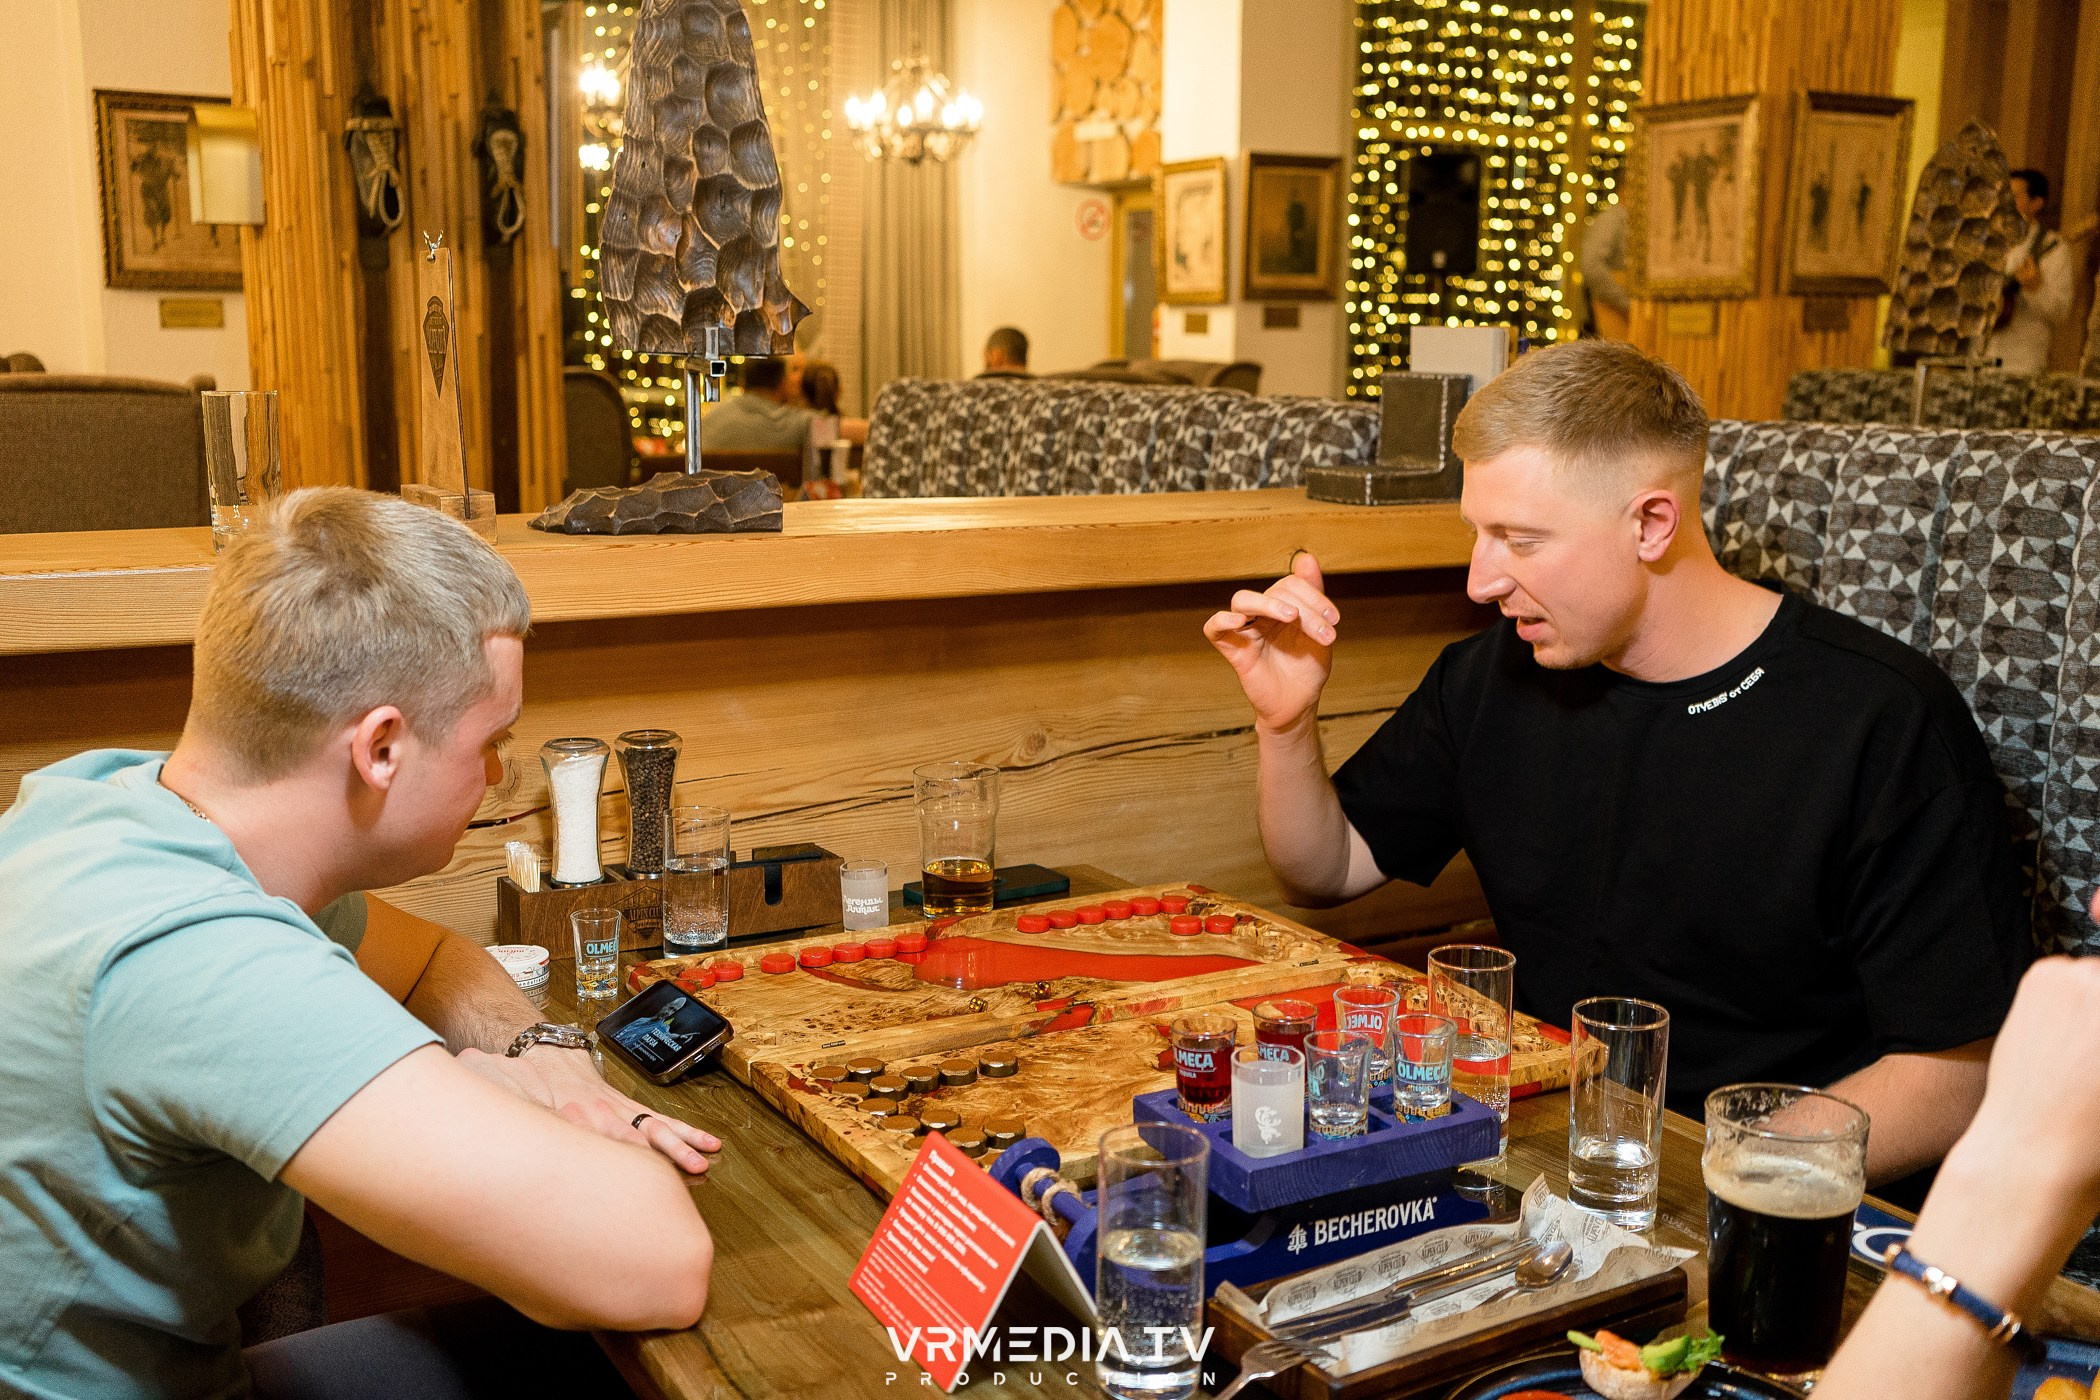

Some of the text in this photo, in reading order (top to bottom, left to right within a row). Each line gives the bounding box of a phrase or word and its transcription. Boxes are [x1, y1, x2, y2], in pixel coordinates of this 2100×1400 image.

[1740, 667, 1765, 691] СЕБЯ
[649, 905, 663, 919] CLU
[1397, 1061, 1448, 1081] OLMECA
[1314, 1196, 1436, 1246] BECHEROVKA
